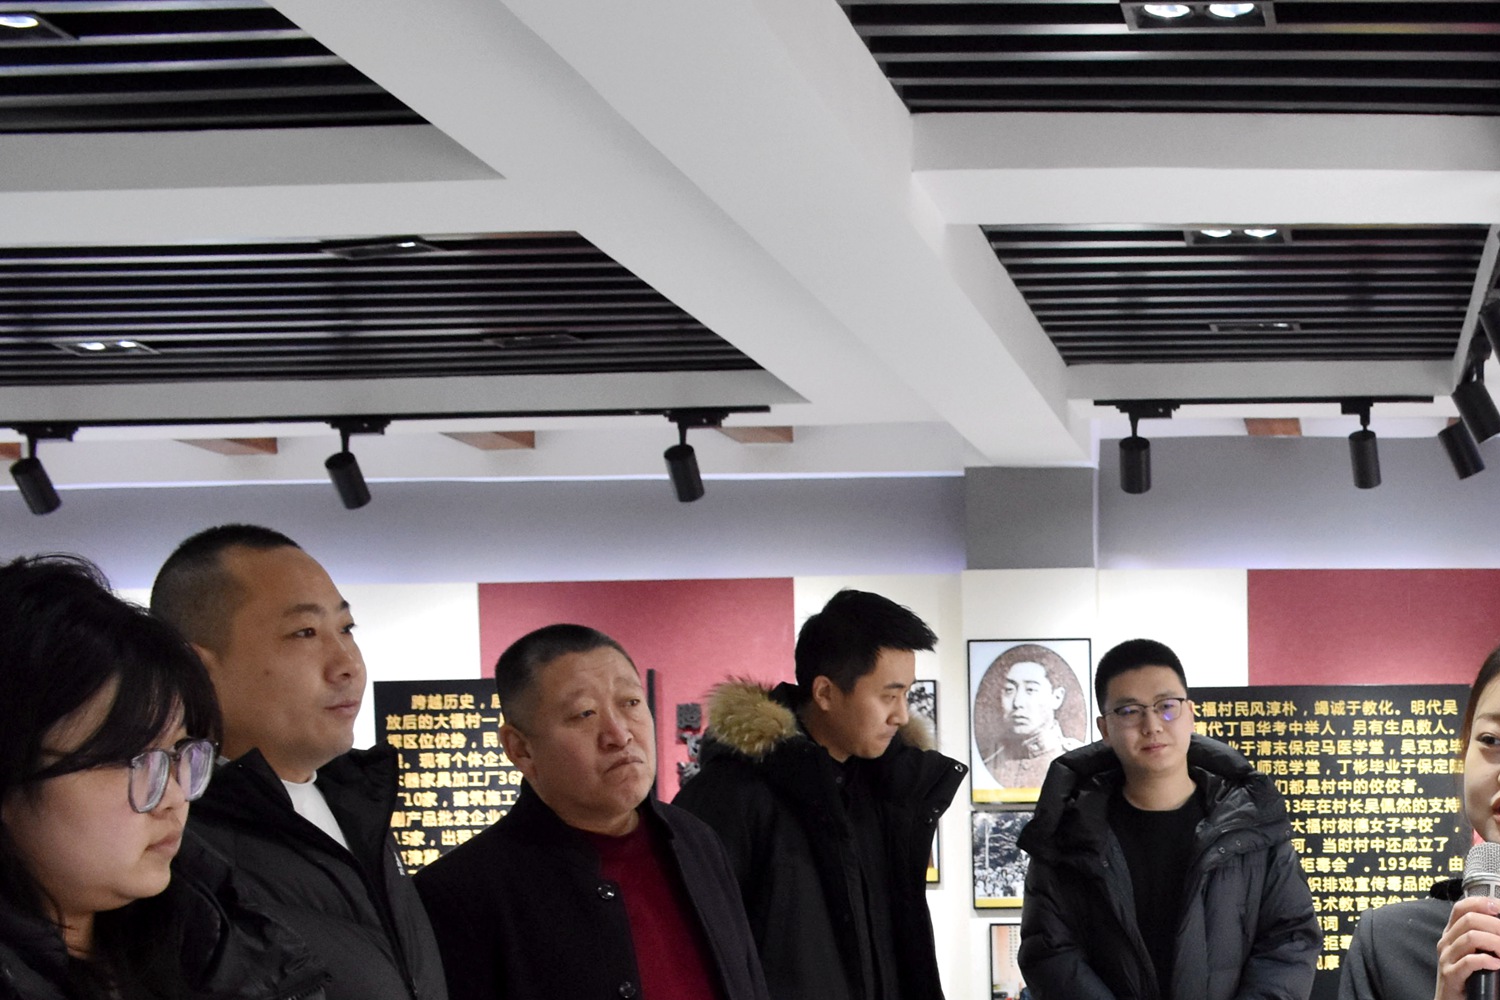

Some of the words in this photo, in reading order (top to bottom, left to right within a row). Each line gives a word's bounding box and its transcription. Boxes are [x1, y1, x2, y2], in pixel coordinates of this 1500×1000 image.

[386, 712, 505, 730] 放后的大福村一
[387, 732, 504, 749] 区位优势，民
[1248, 759, 1466, 776] 师范学堂，丁彬毕业于保定陆
[1274, 779, 1425, 796] 们都是村中的佼佼者。
[397, 790, 521, 808] 10家，建筑施工
[390, 809, 508, 828] 副产品批发企业
[393, 829, 483, 847] 5家，出租
[1291, 836, 1449, 854] 河。当时村中还成立了
[1316, 954, 1341, 971] 摩
